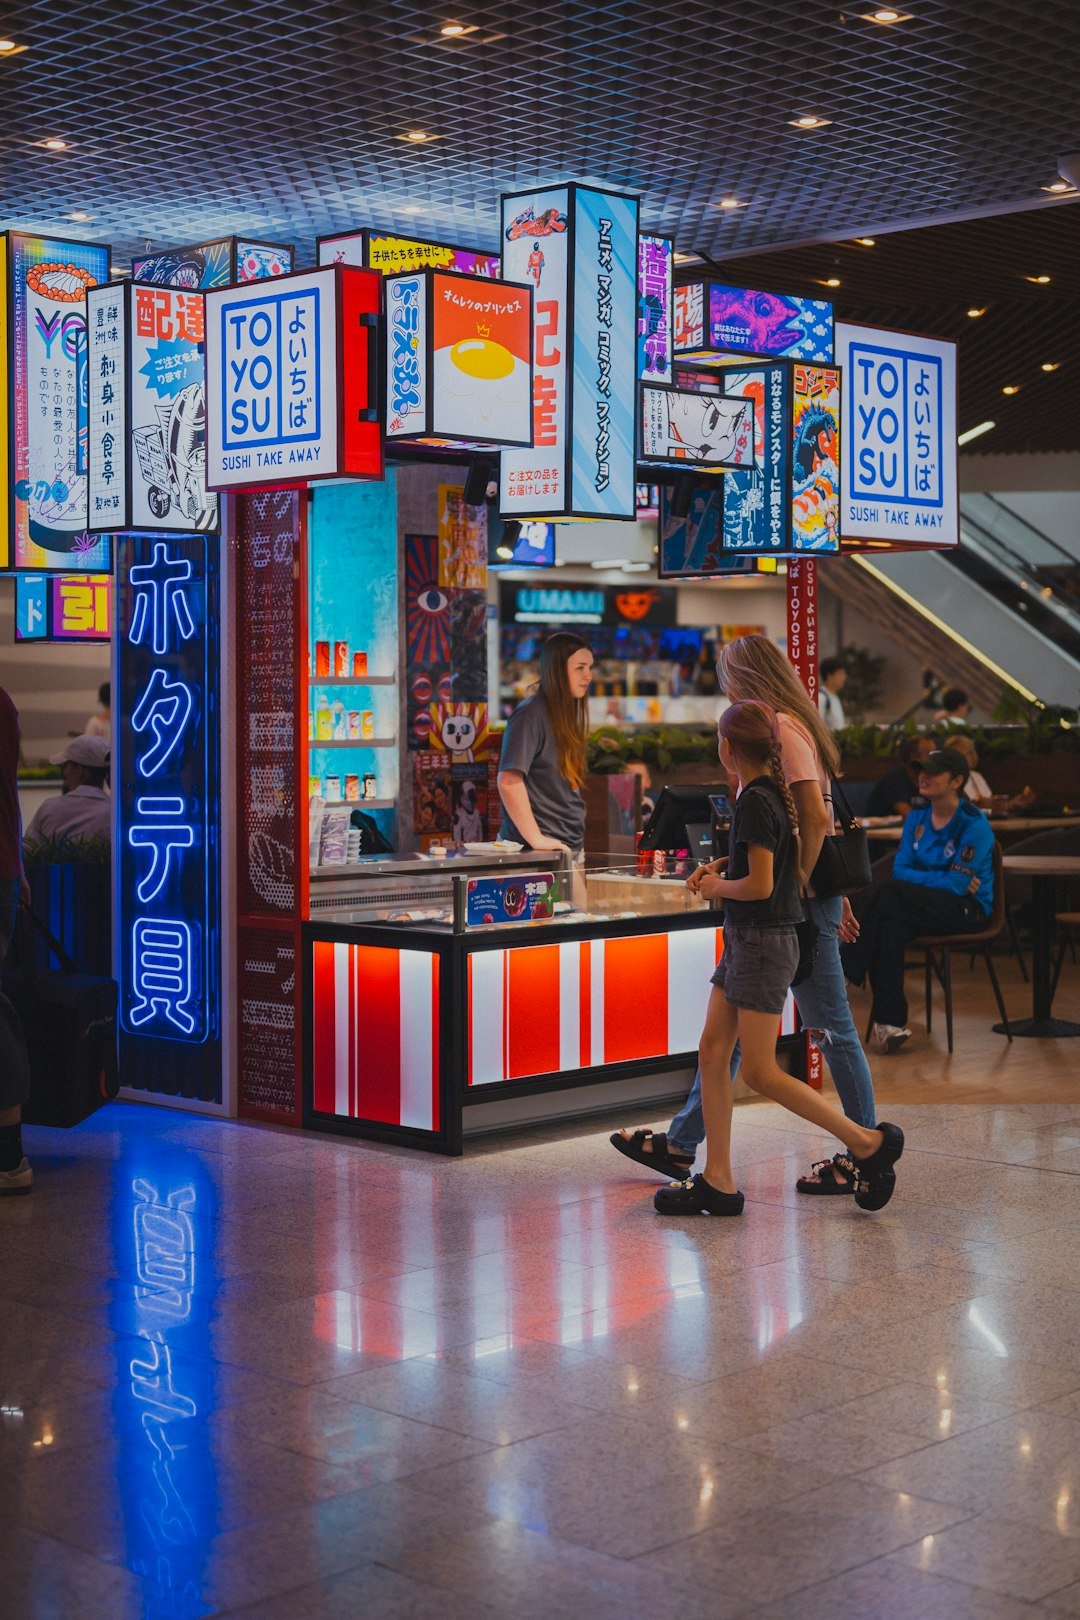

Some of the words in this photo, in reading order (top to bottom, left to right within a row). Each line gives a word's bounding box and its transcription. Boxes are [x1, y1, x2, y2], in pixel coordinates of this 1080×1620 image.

[229, 311, 272, 351] TO
[230, 354, 272, 393] YO
[288, 305, 313, 430] よいちば
[793, 366, 841, 398] ゴジラ
[857, 359, 899, 399] TO
[231, 396, 271, 436] SU
[858, 404, 899, 444] YO
[913, 368, 936, 492] よいちば
[222, 453, 252, 471] SUSHI
[256, 450, 283, 467] TAKE
[288, 446, 321, 464] AWAY
[508, 469, 559, 483] ご注文の品を
[858, 447, 897, 488] SU
[508, 482, 559, 497] お届けします
[850, 506, 880, 522] SUSHI
[884, 508, 910, 526] TAKE
[914, 511, 943, 529] AWAY
[518, 588, 605, 614] UMAMI
[790, 585, 801, 660] TOYOSU
[806, 602, 816, 656] よいちば
[129, 543, 195, 1033] ホタテ貝
